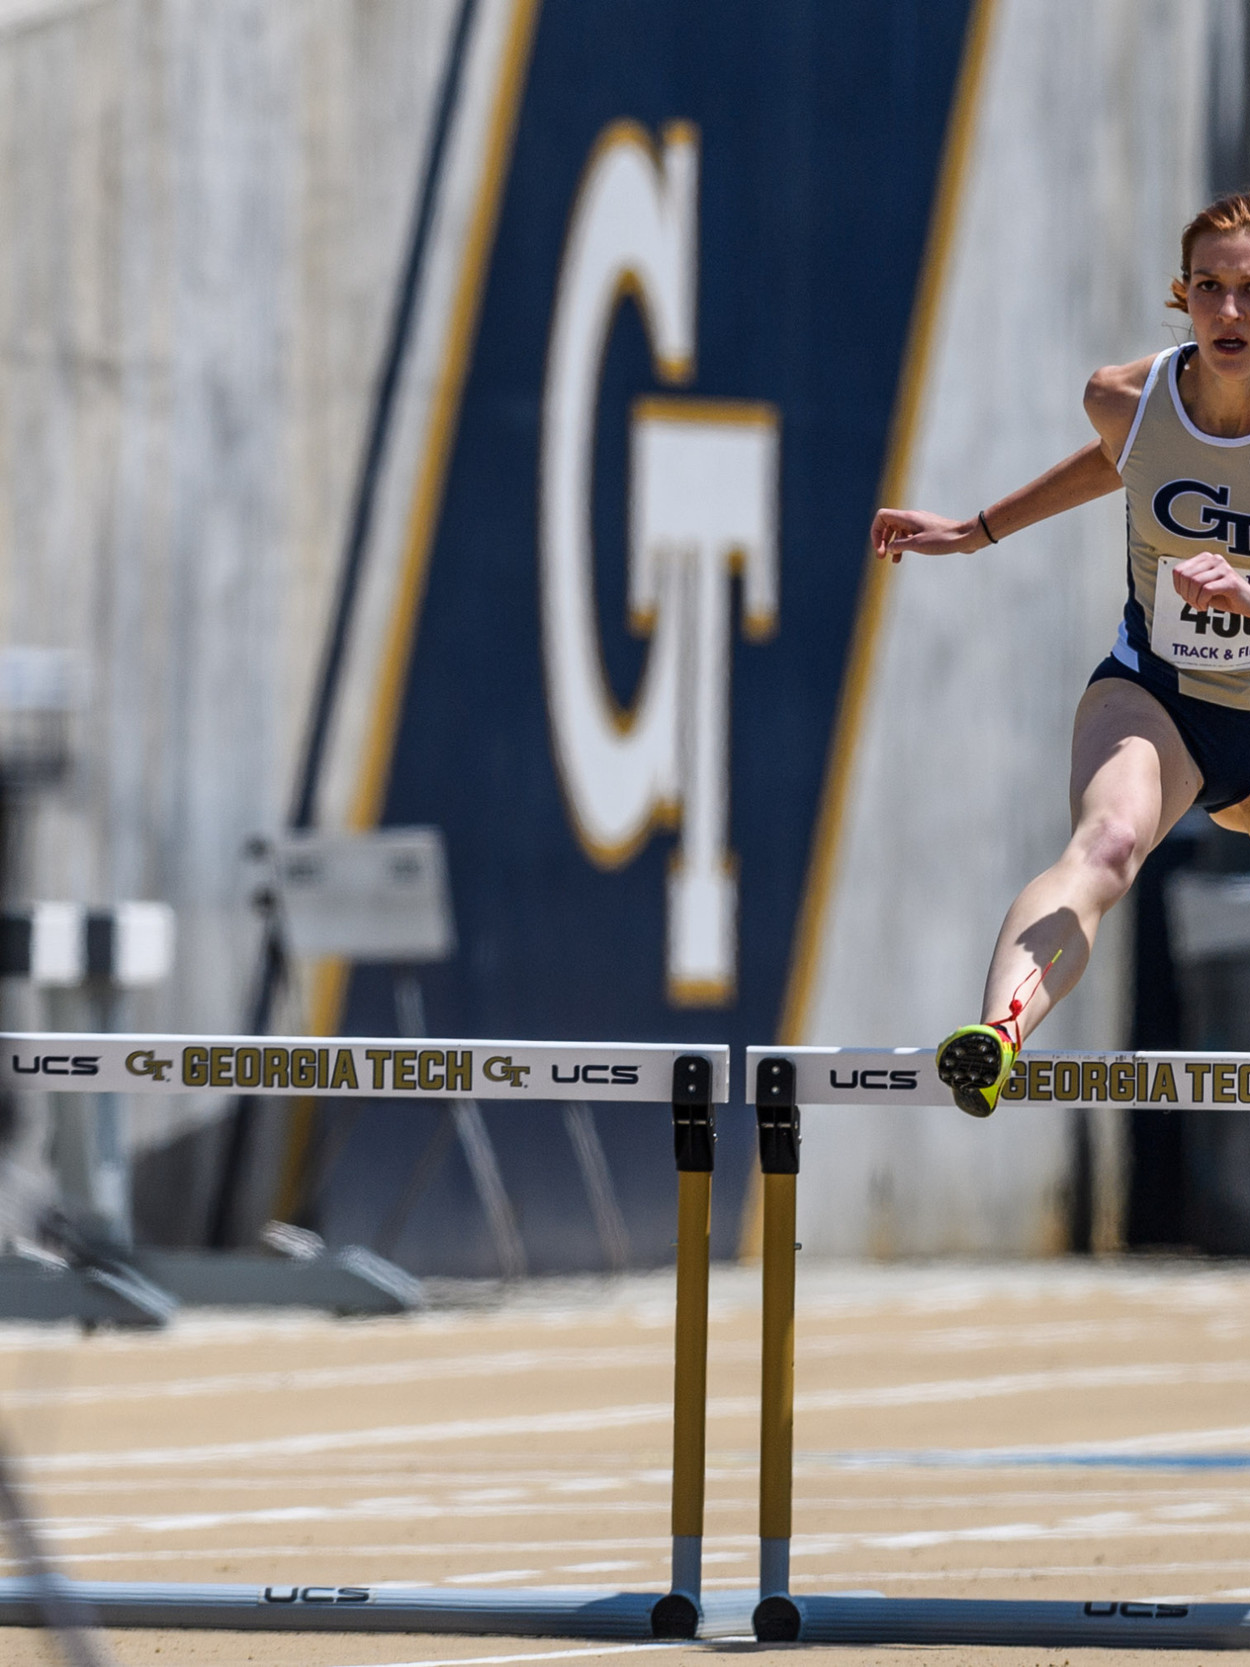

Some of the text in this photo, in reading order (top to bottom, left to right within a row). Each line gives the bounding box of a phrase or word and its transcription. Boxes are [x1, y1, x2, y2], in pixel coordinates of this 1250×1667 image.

[1172, 643, 1218, 660] TRACK
[1223, 649, 1233, 660] &
[13, 1055, 99, 1075] UCS
[182, 1047, 358, 1089] GEORGIA
[365, 1049, 472, 1091] TECH
[552, 1064, 639, 1085] UCS
[830, 1069, 917, 1089] UCS
[1000, 1061, 1178, 1102] GEORGIA
[264, 1587, 370, 1603] UCS
[1084, 1601, 1188, 1618] UCS
